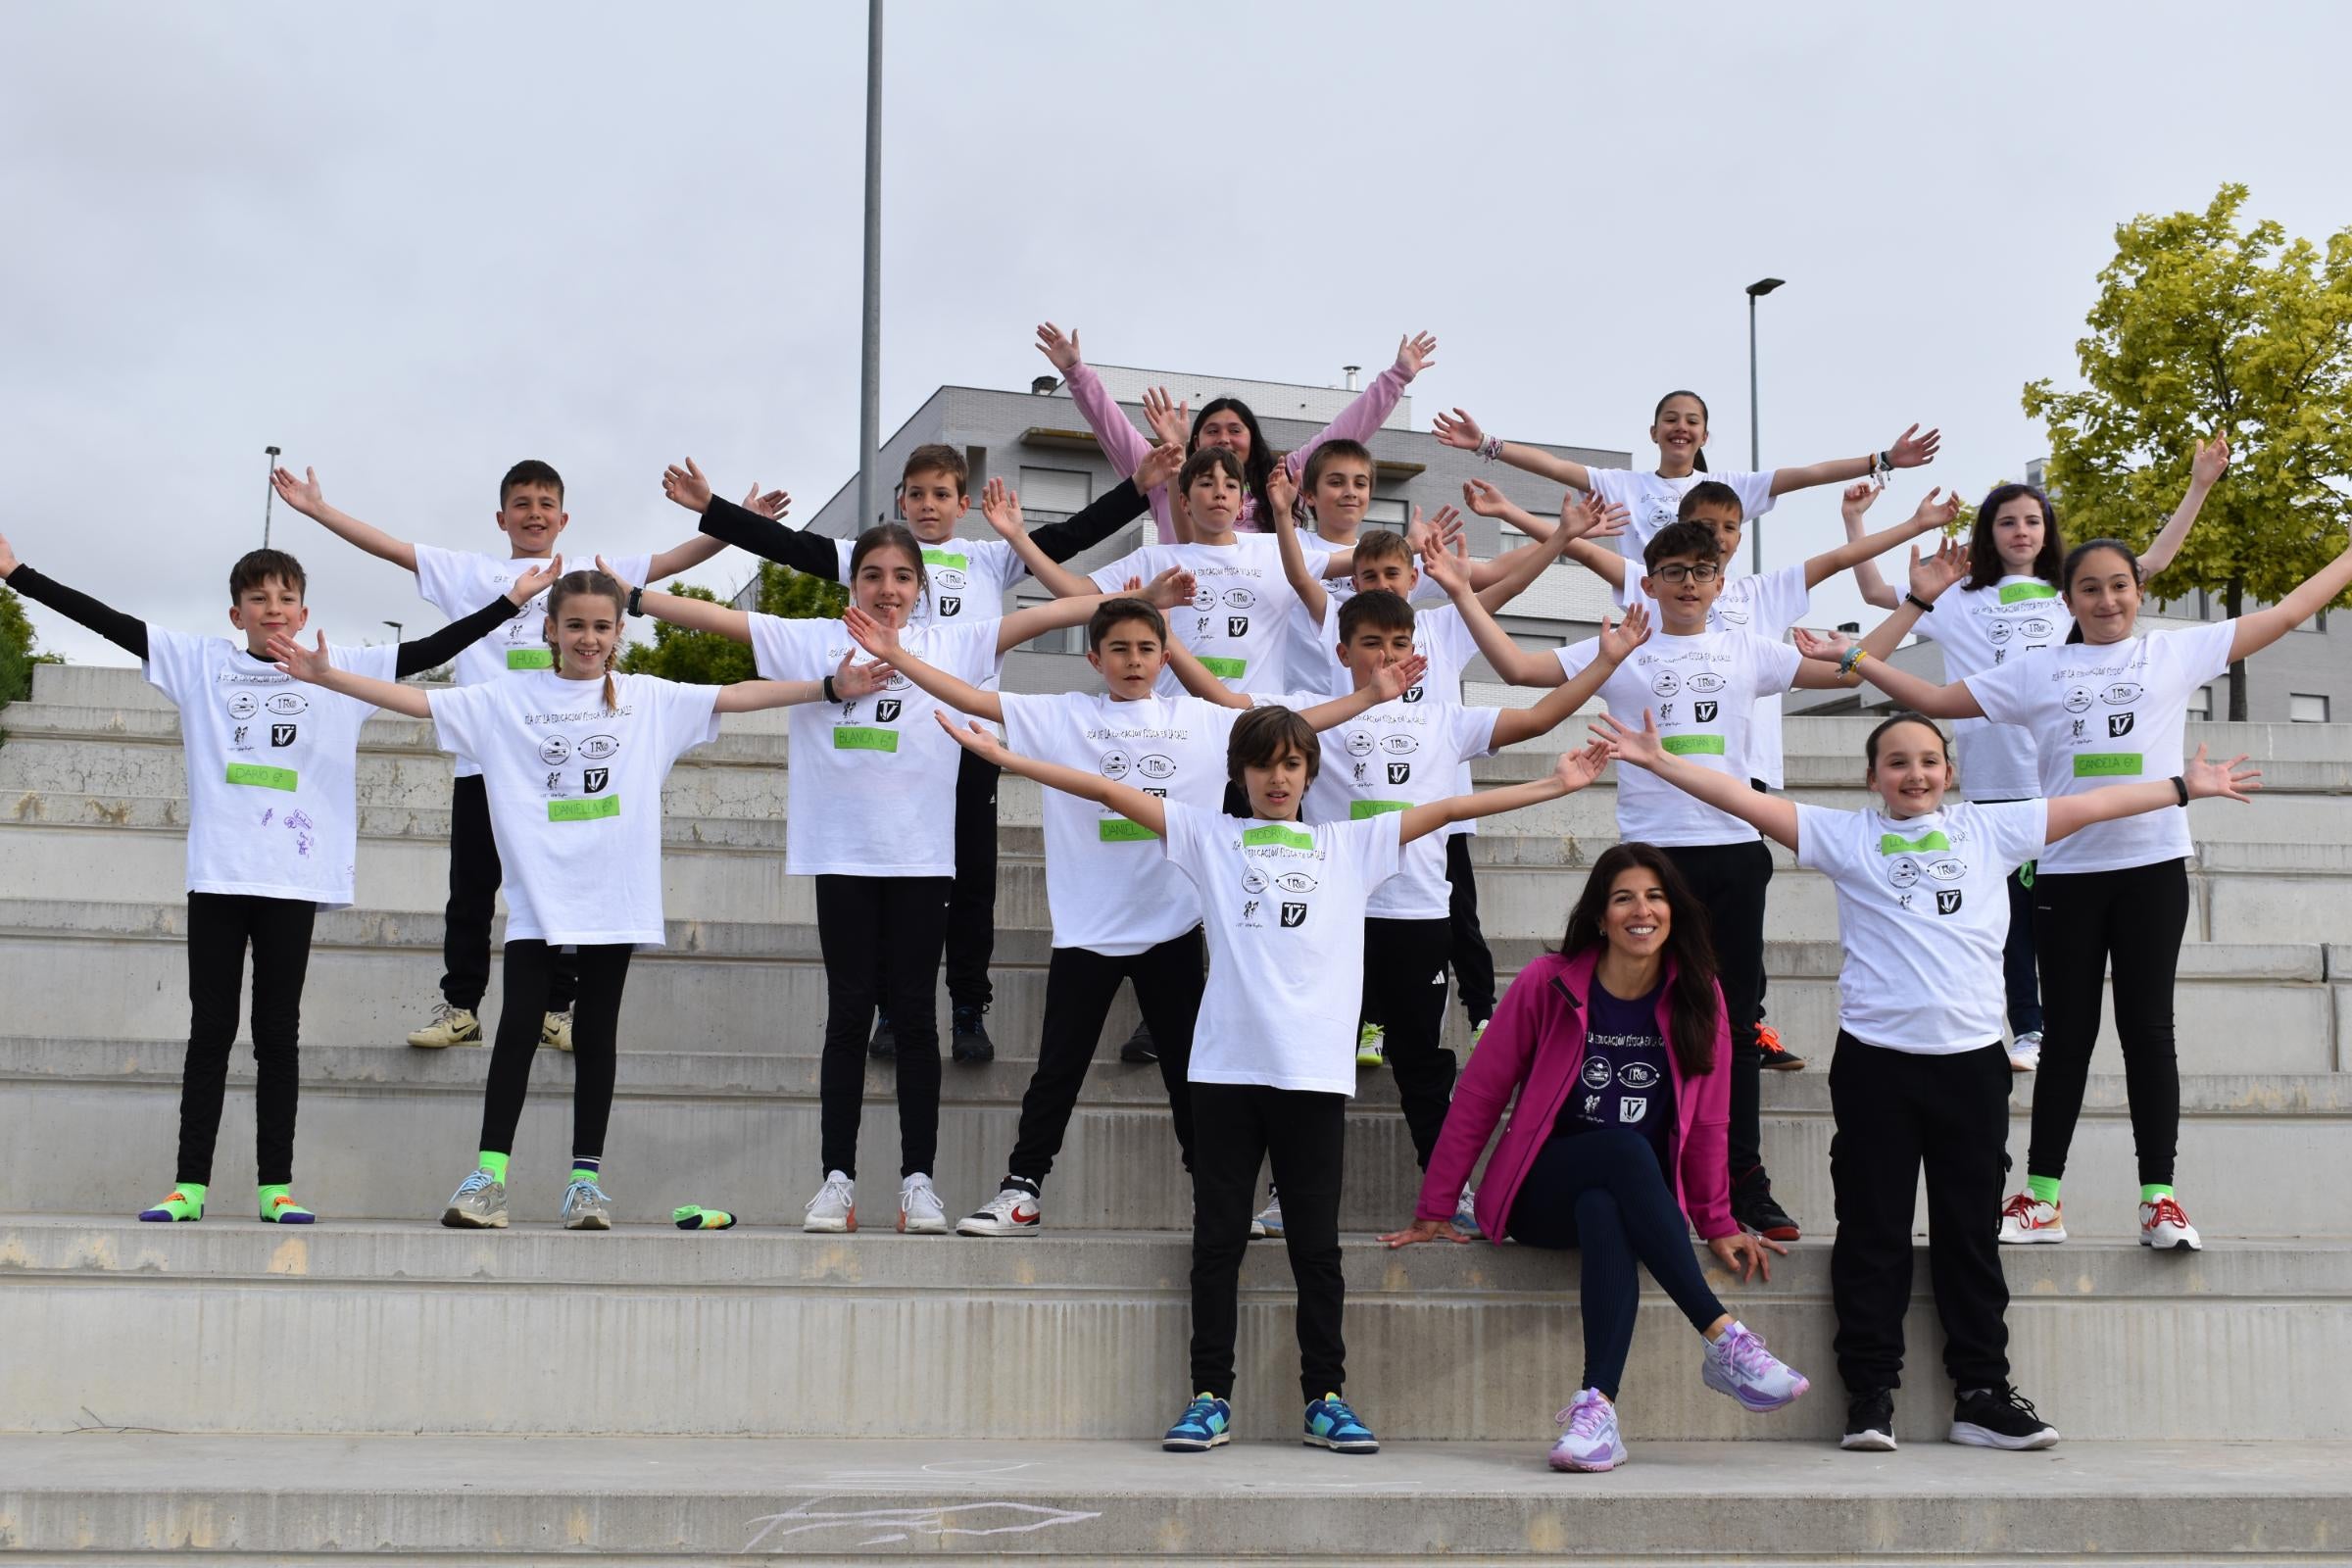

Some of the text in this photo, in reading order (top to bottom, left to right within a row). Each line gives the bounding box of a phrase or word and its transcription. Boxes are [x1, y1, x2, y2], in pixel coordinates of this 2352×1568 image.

[839, 730, 874, 746] BLANCA
[2078, 758, 2121, 770] CANDELA
[554, 802, 599, 817] DANIELLA
[1103, 823, 1138, 837] DANIEL
